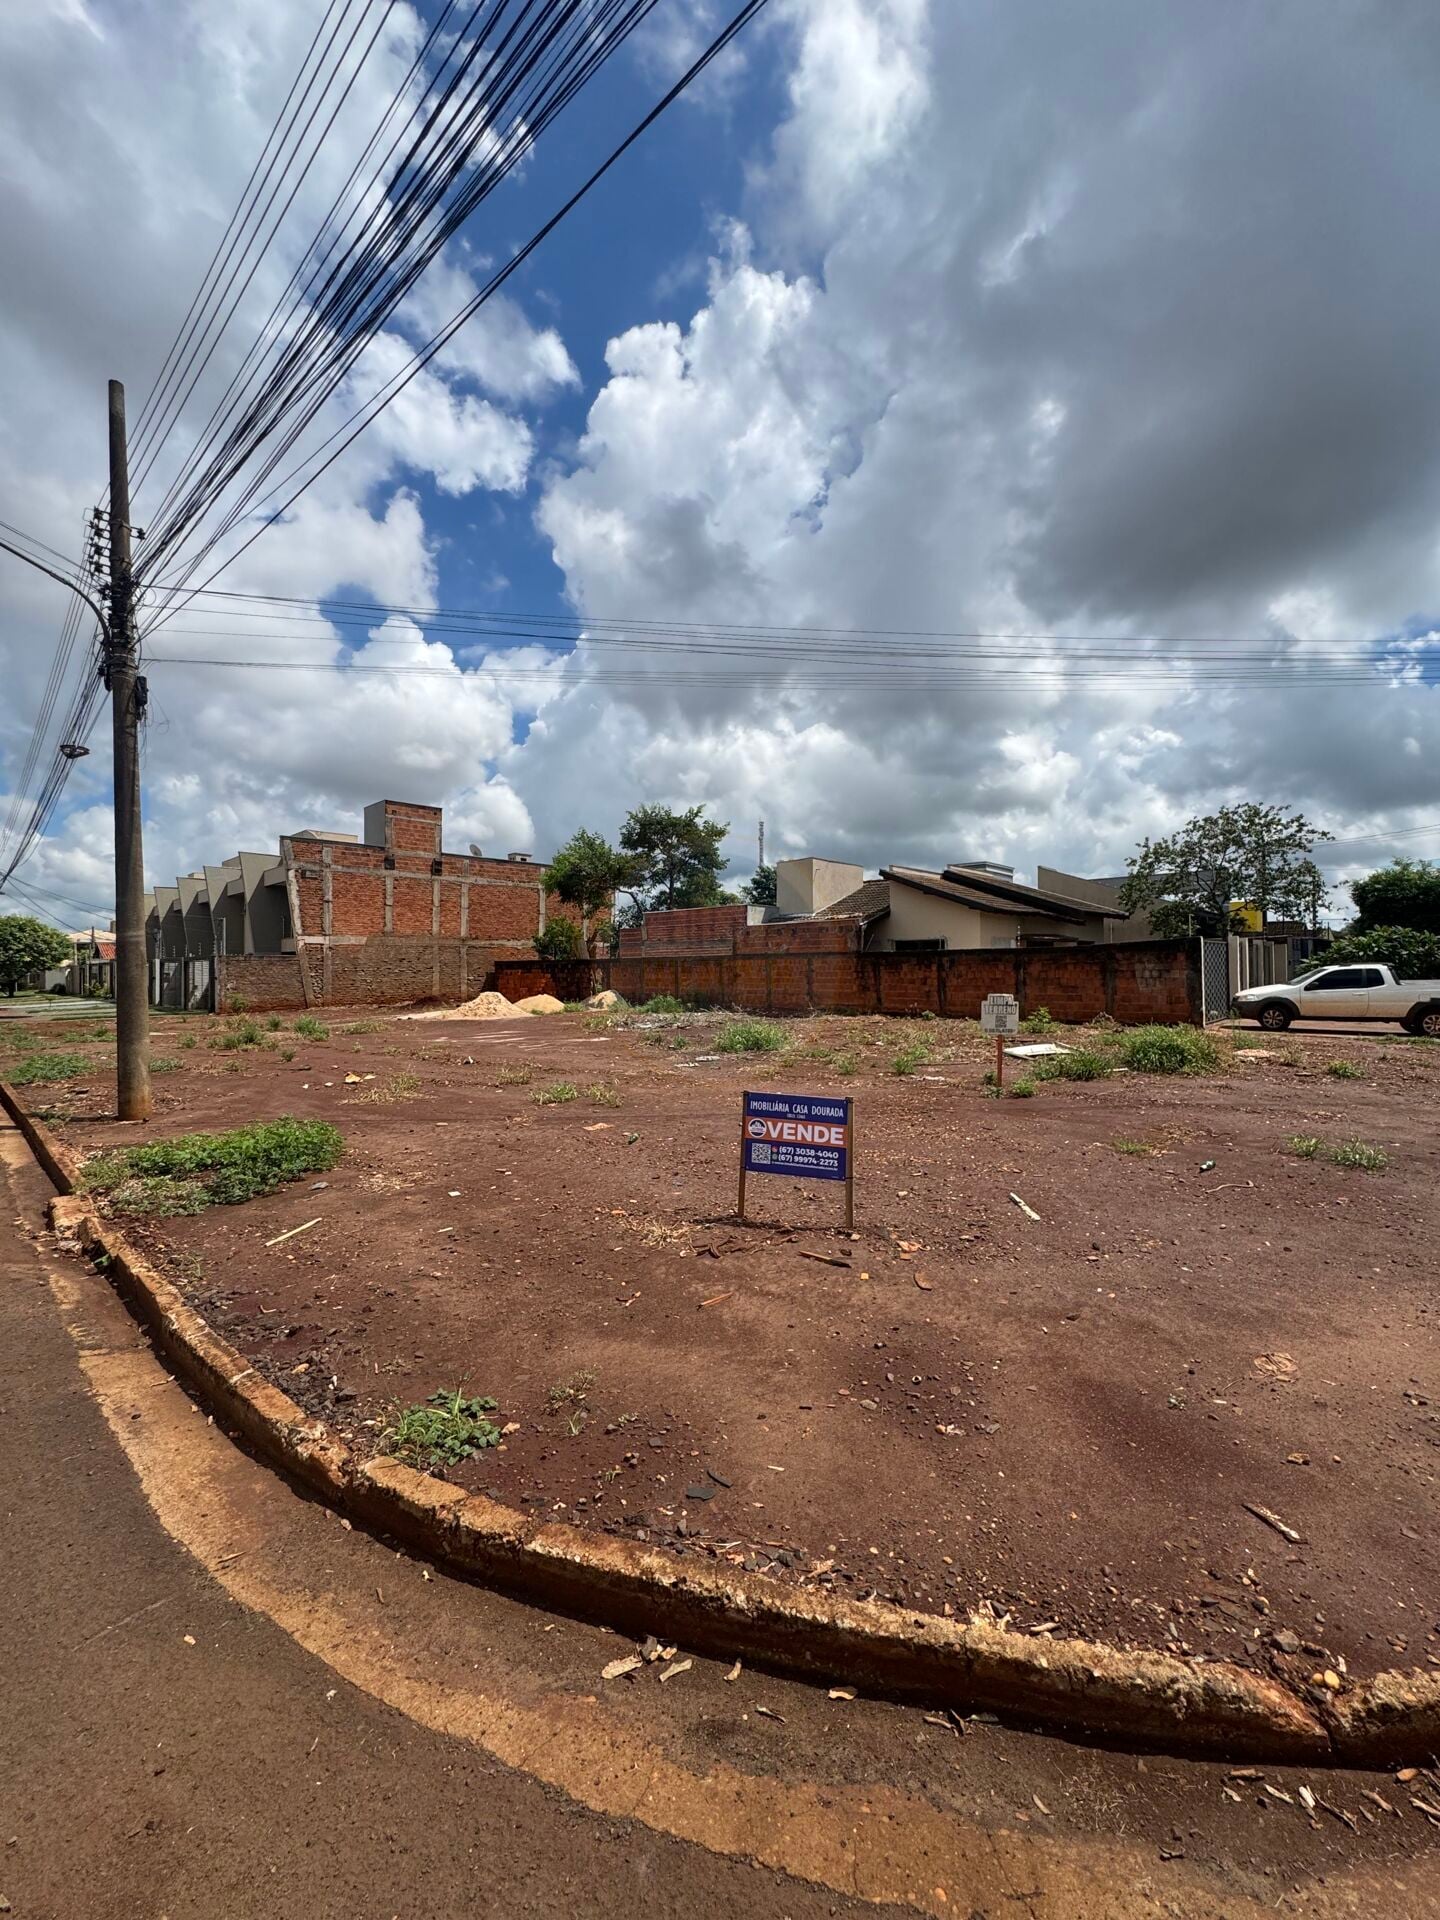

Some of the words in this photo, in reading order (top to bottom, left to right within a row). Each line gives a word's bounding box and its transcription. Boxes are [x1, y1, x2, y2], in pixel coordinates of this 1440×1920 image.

[984, 1005, 1016, 1015] TERRENO
[751, 1101, 789, 1112] IMOBILIÁRIA
[793, 1104, 808, 1114] CASA
[812, 1106, 844, 1117] DOURADA
[767, 1121, 844, 1145] VENDE
[779, 1146, 794, 1155] (67)
[795, 1147, 838, 1159] 3038-4040
[778, 1153, 792, 1162] (67)
[794, 1156, 838, 1167] 99974-2273
